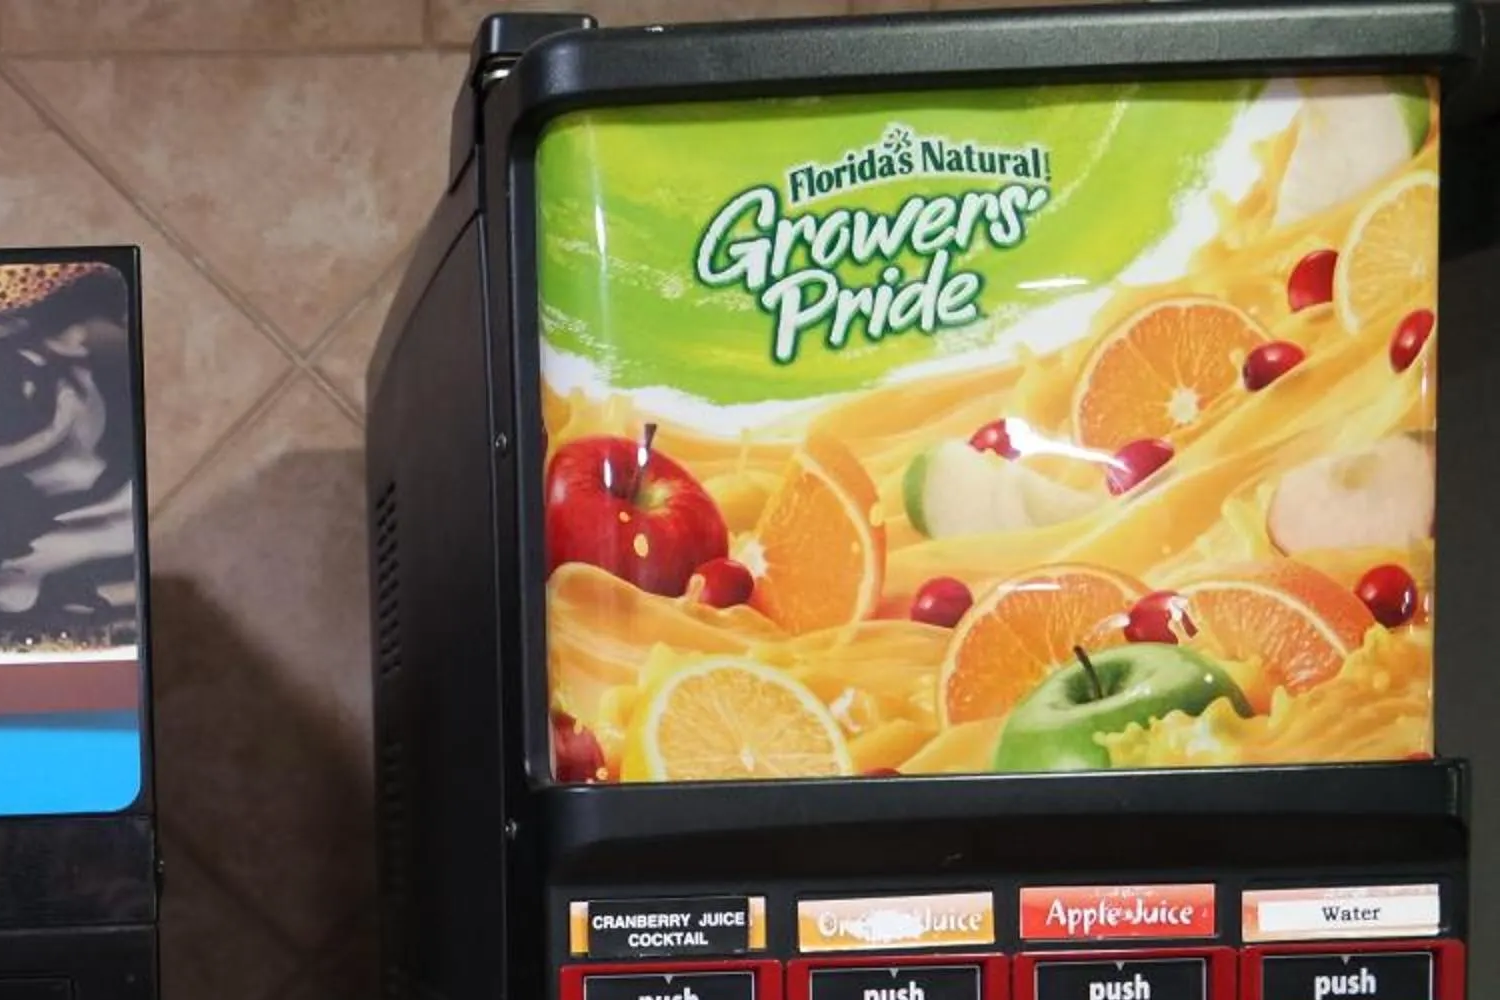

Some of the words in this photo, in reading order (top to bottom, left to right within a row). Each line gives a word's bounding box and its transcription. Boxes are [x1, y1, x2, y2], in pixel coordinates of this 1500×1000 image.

[760, 246, 986, 364] Pride
[592, 914, 691, 930] CRANBERRY
[699, 911, 745, 927] JUICE
[1045, 897, 1122, 935] Apple
[1130, 897, 1195, 925] Juice
[1322, 905, 1381, 921] Water
[627, 932, 709, 947] COCKTAIL
